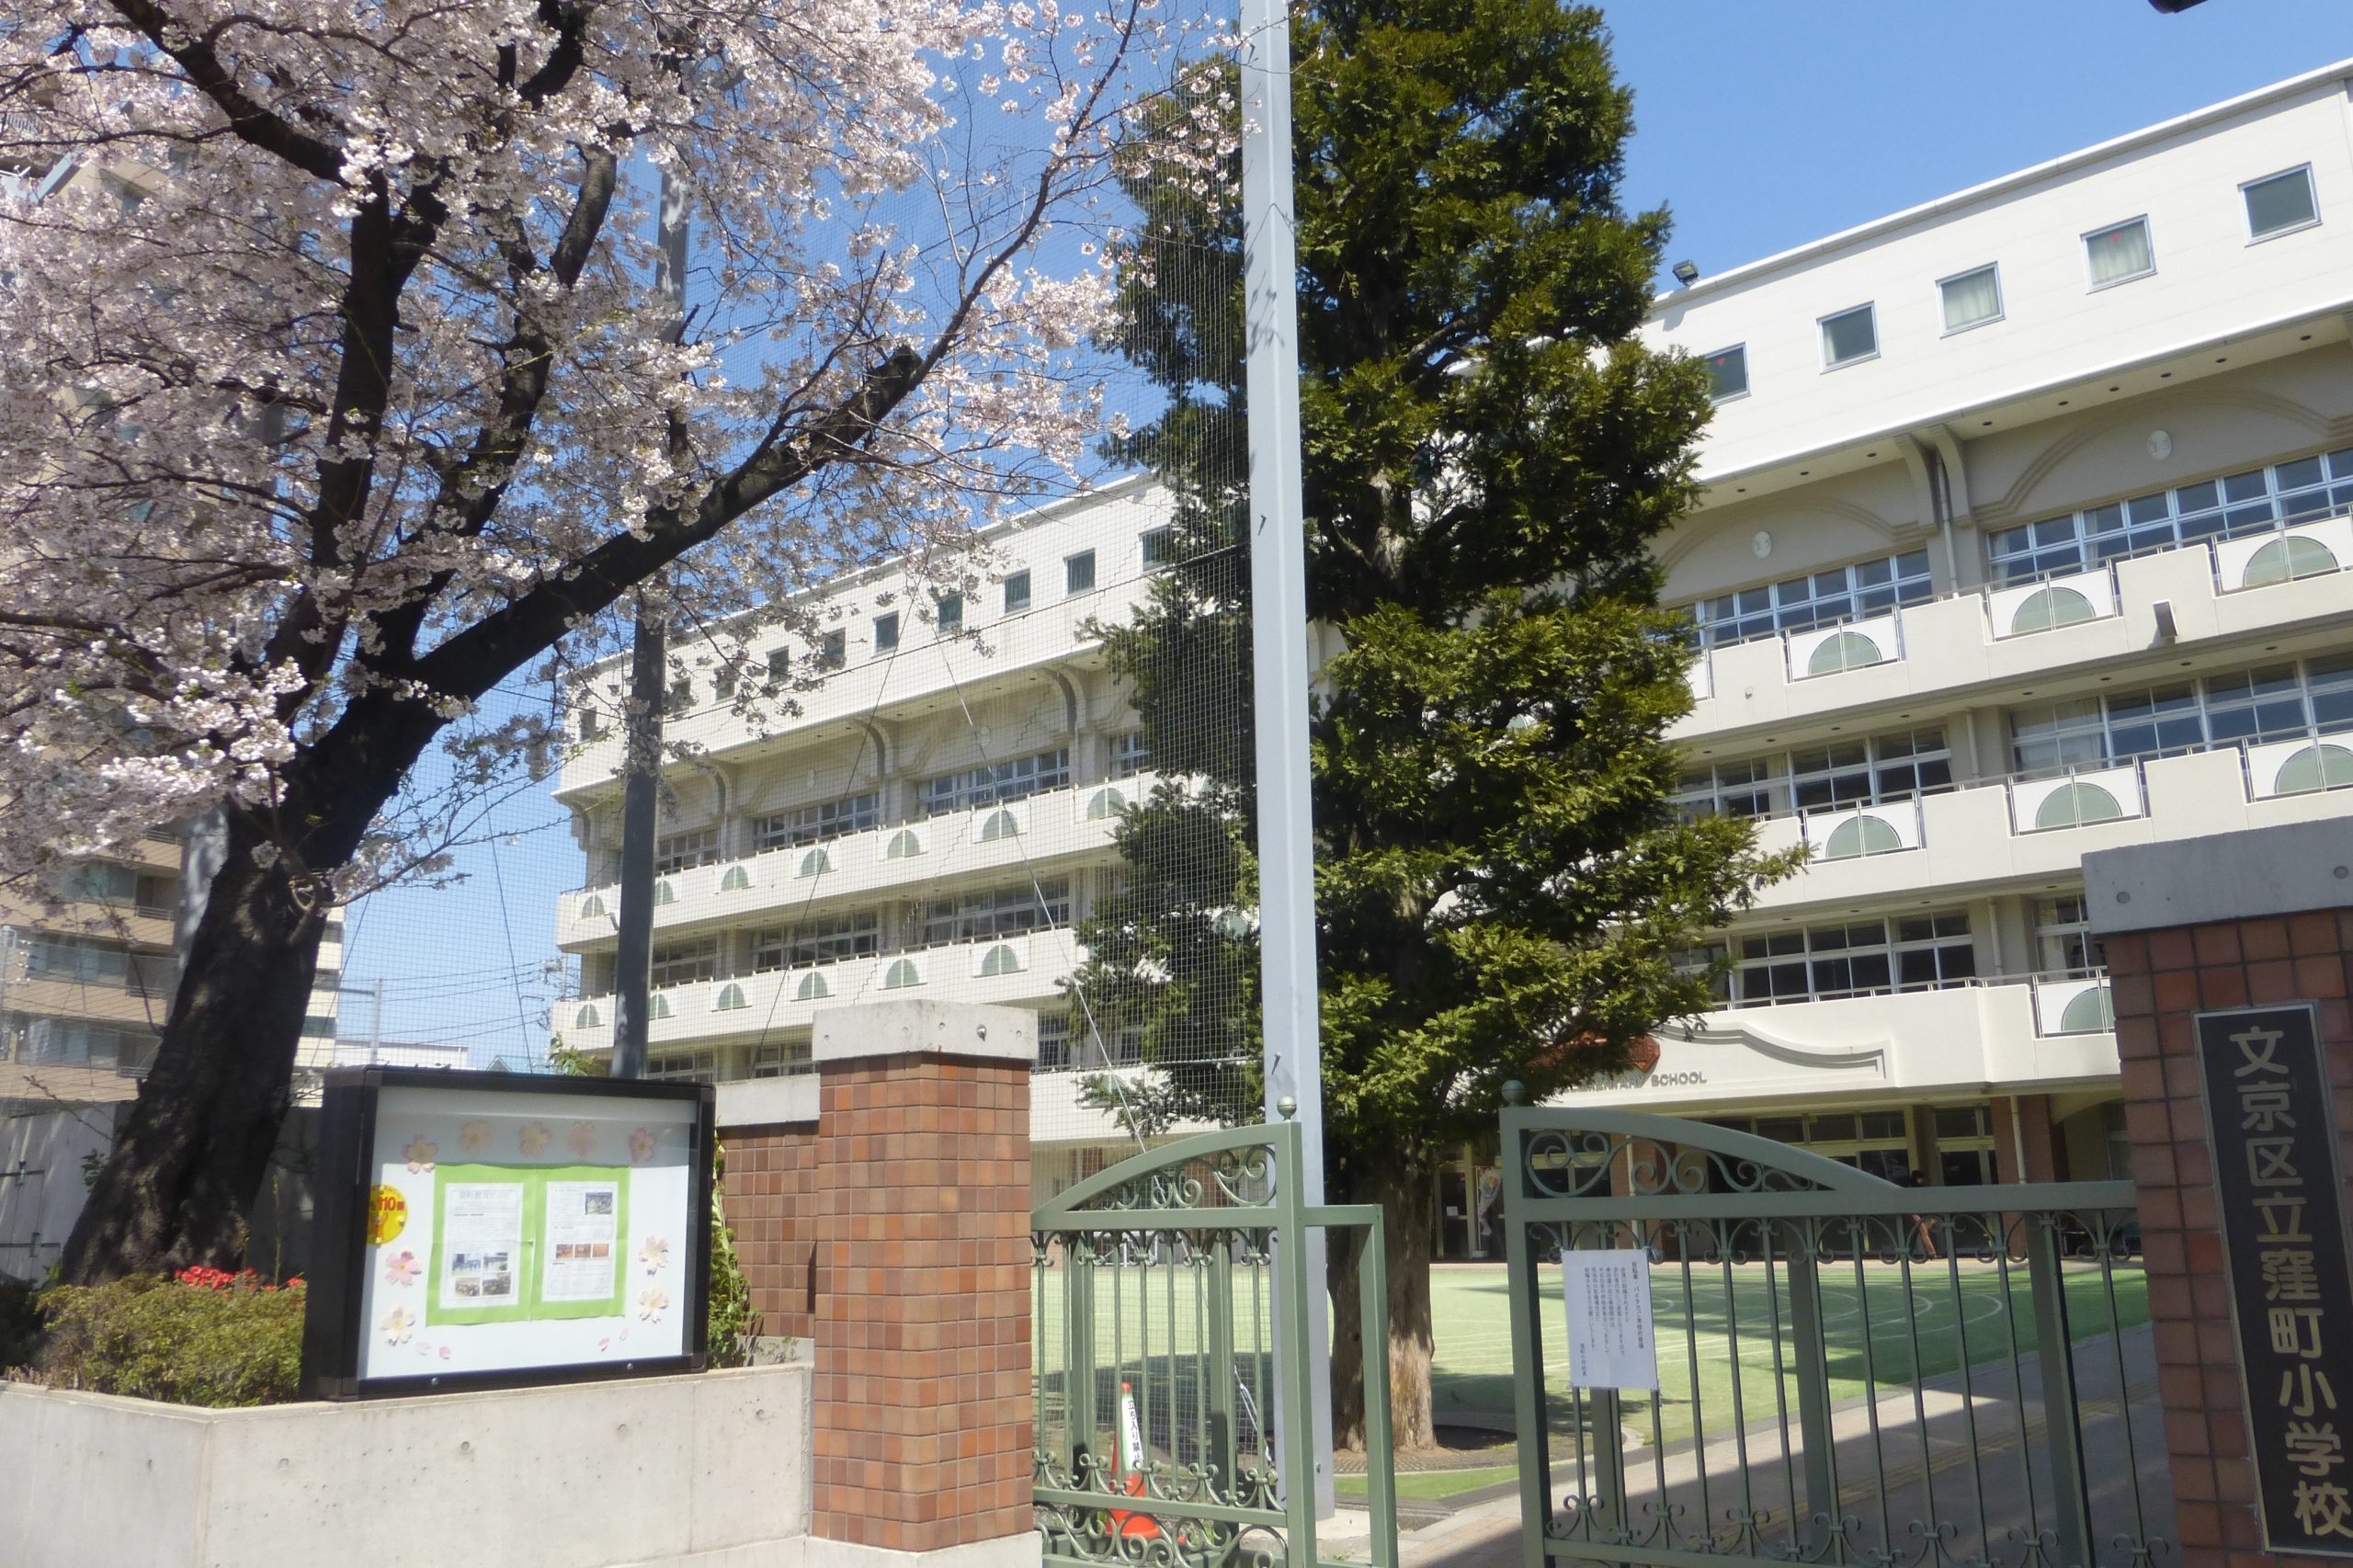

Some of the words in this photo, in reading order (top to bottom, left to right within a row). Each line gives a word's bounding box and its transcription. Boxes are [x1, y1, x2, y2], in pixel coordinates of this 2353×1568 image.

[1651, 1071, 1708, 1087] SCHOOL
[2229, 1025, 2353, 1538] 文京区立窪町小学校
[1128, 1400, 1142, 1462] 立ち入り禁止
